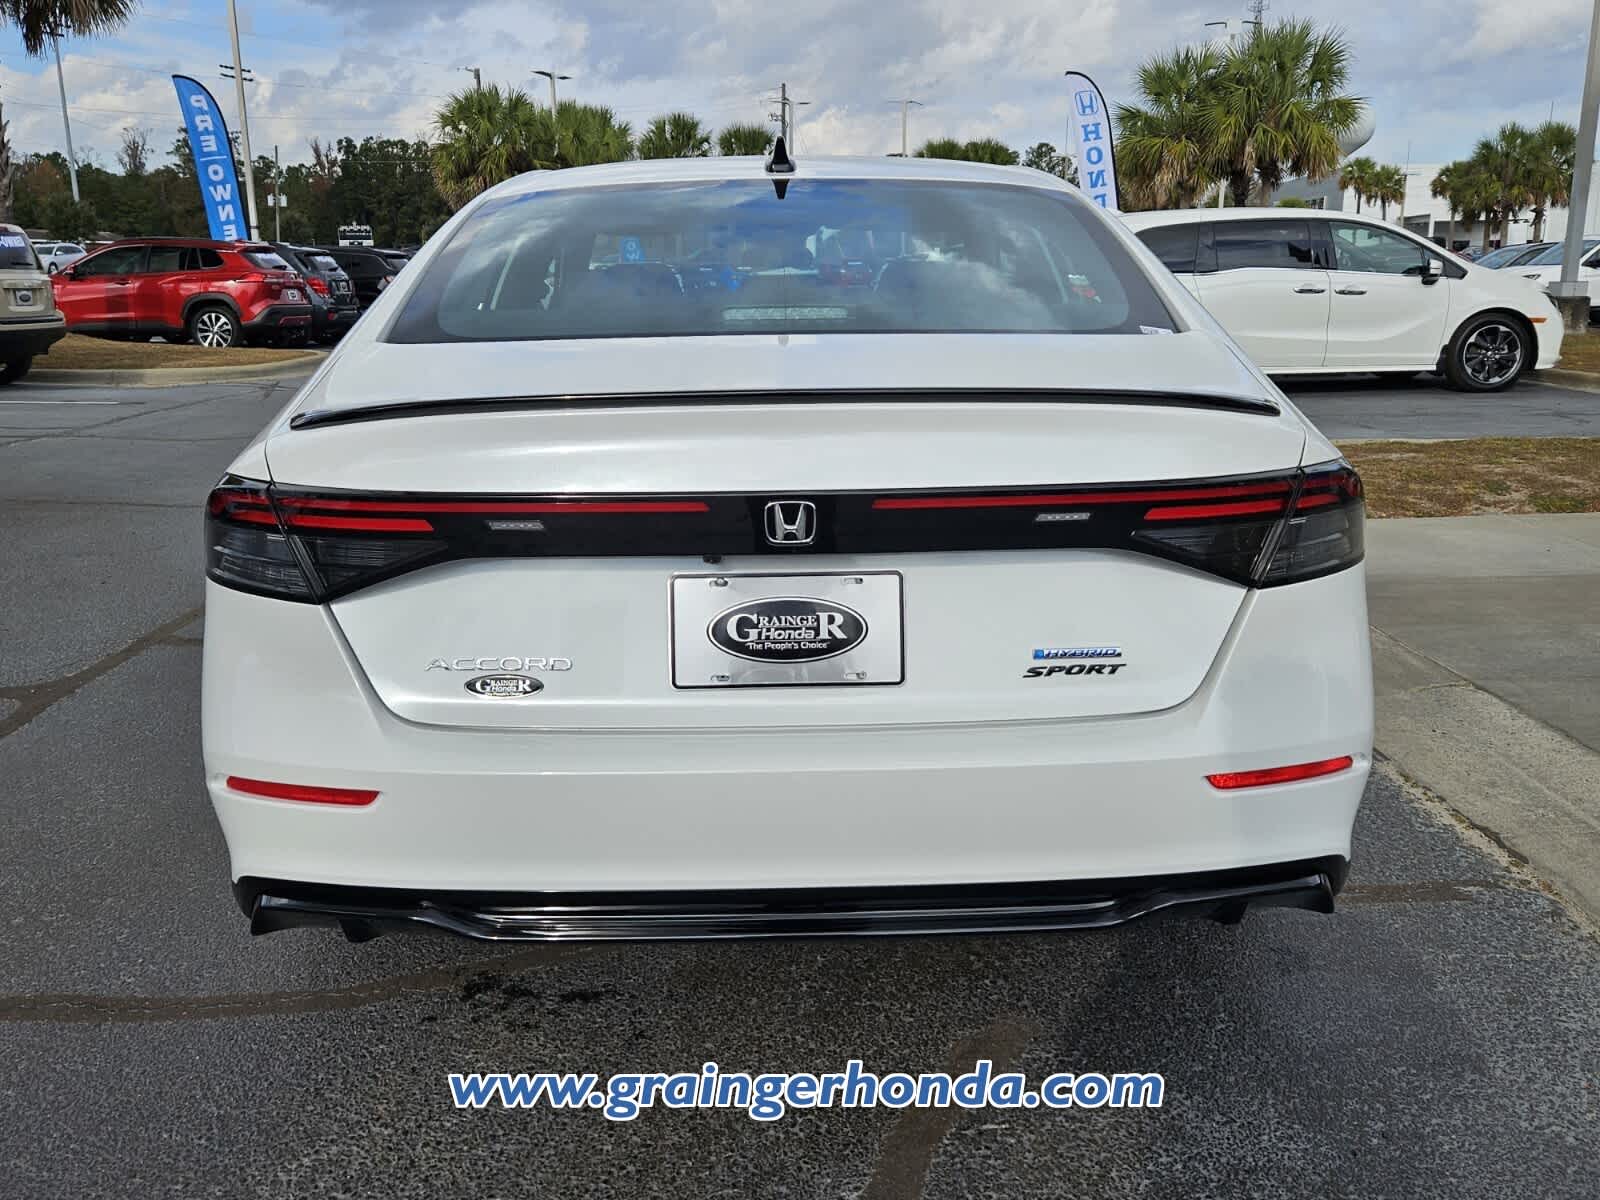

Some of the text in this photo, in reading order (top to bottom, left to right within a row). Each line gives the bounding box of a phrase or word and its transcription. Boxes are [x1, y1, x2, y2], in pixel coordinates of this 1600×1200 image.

[727, 612, 848, 642] GRAINGER
[760, 628, 815, 640] Honda
[1043, 648, 1119, 658] HYBRID
[425, 656, 573, 671] ACCORD
[1022, 663, 1126, 678] SPORT
